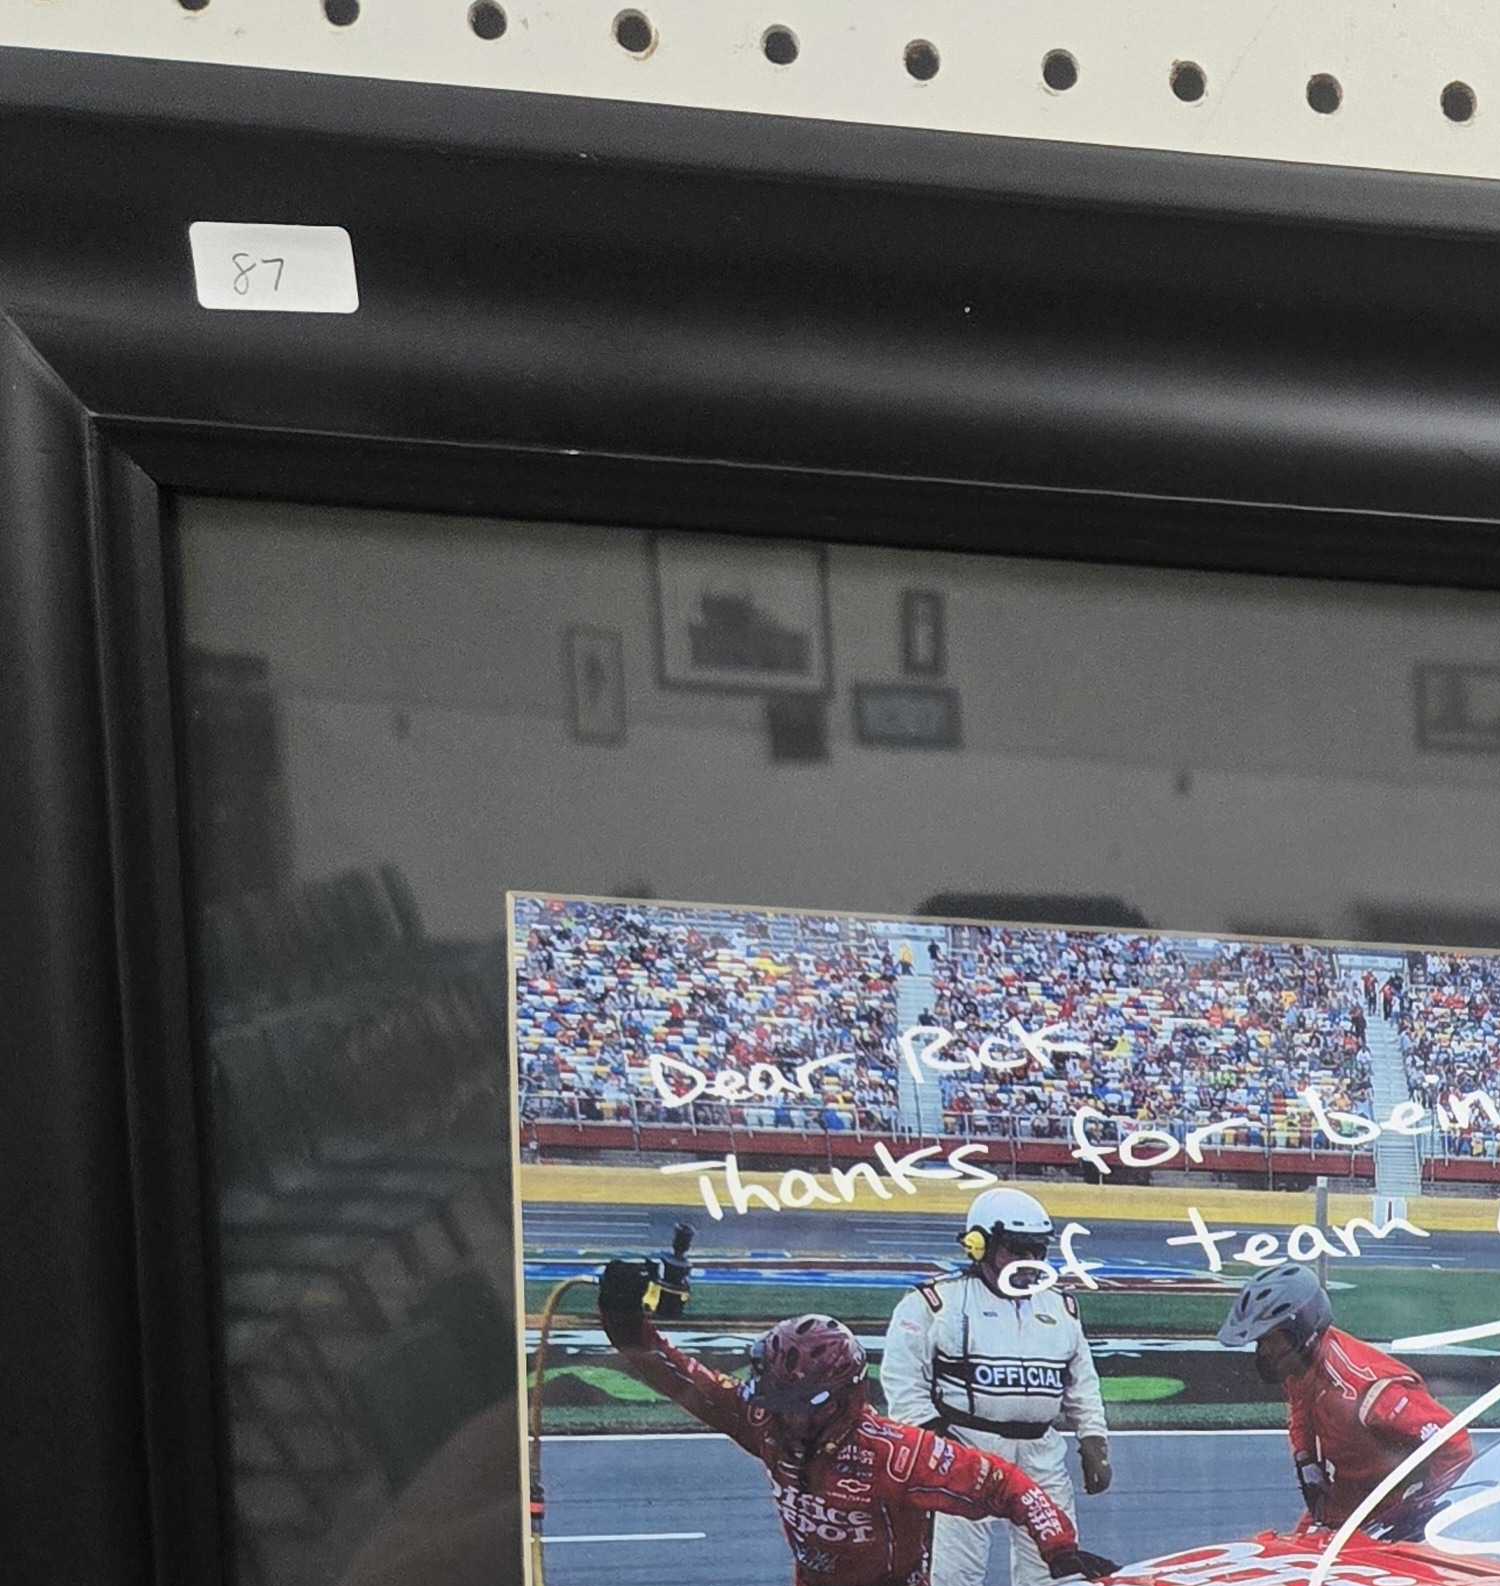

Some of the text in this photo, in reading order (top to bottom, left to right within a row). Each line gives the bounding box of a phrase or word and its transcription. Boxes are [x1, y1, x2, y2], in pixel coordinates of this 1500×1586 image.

[232, 252, 284, 295] 87
[649, 1017, 1088, 1107] Dear Rick
[660, 1140, 998, 1220] Thanks
[1072, 1106, 1262, 1174] for
[997, 1221, 1102, 1297] of
[1167, 1206, 1430, 1272] team
[974, 1364, 1064, 1388] OFFICIAL
